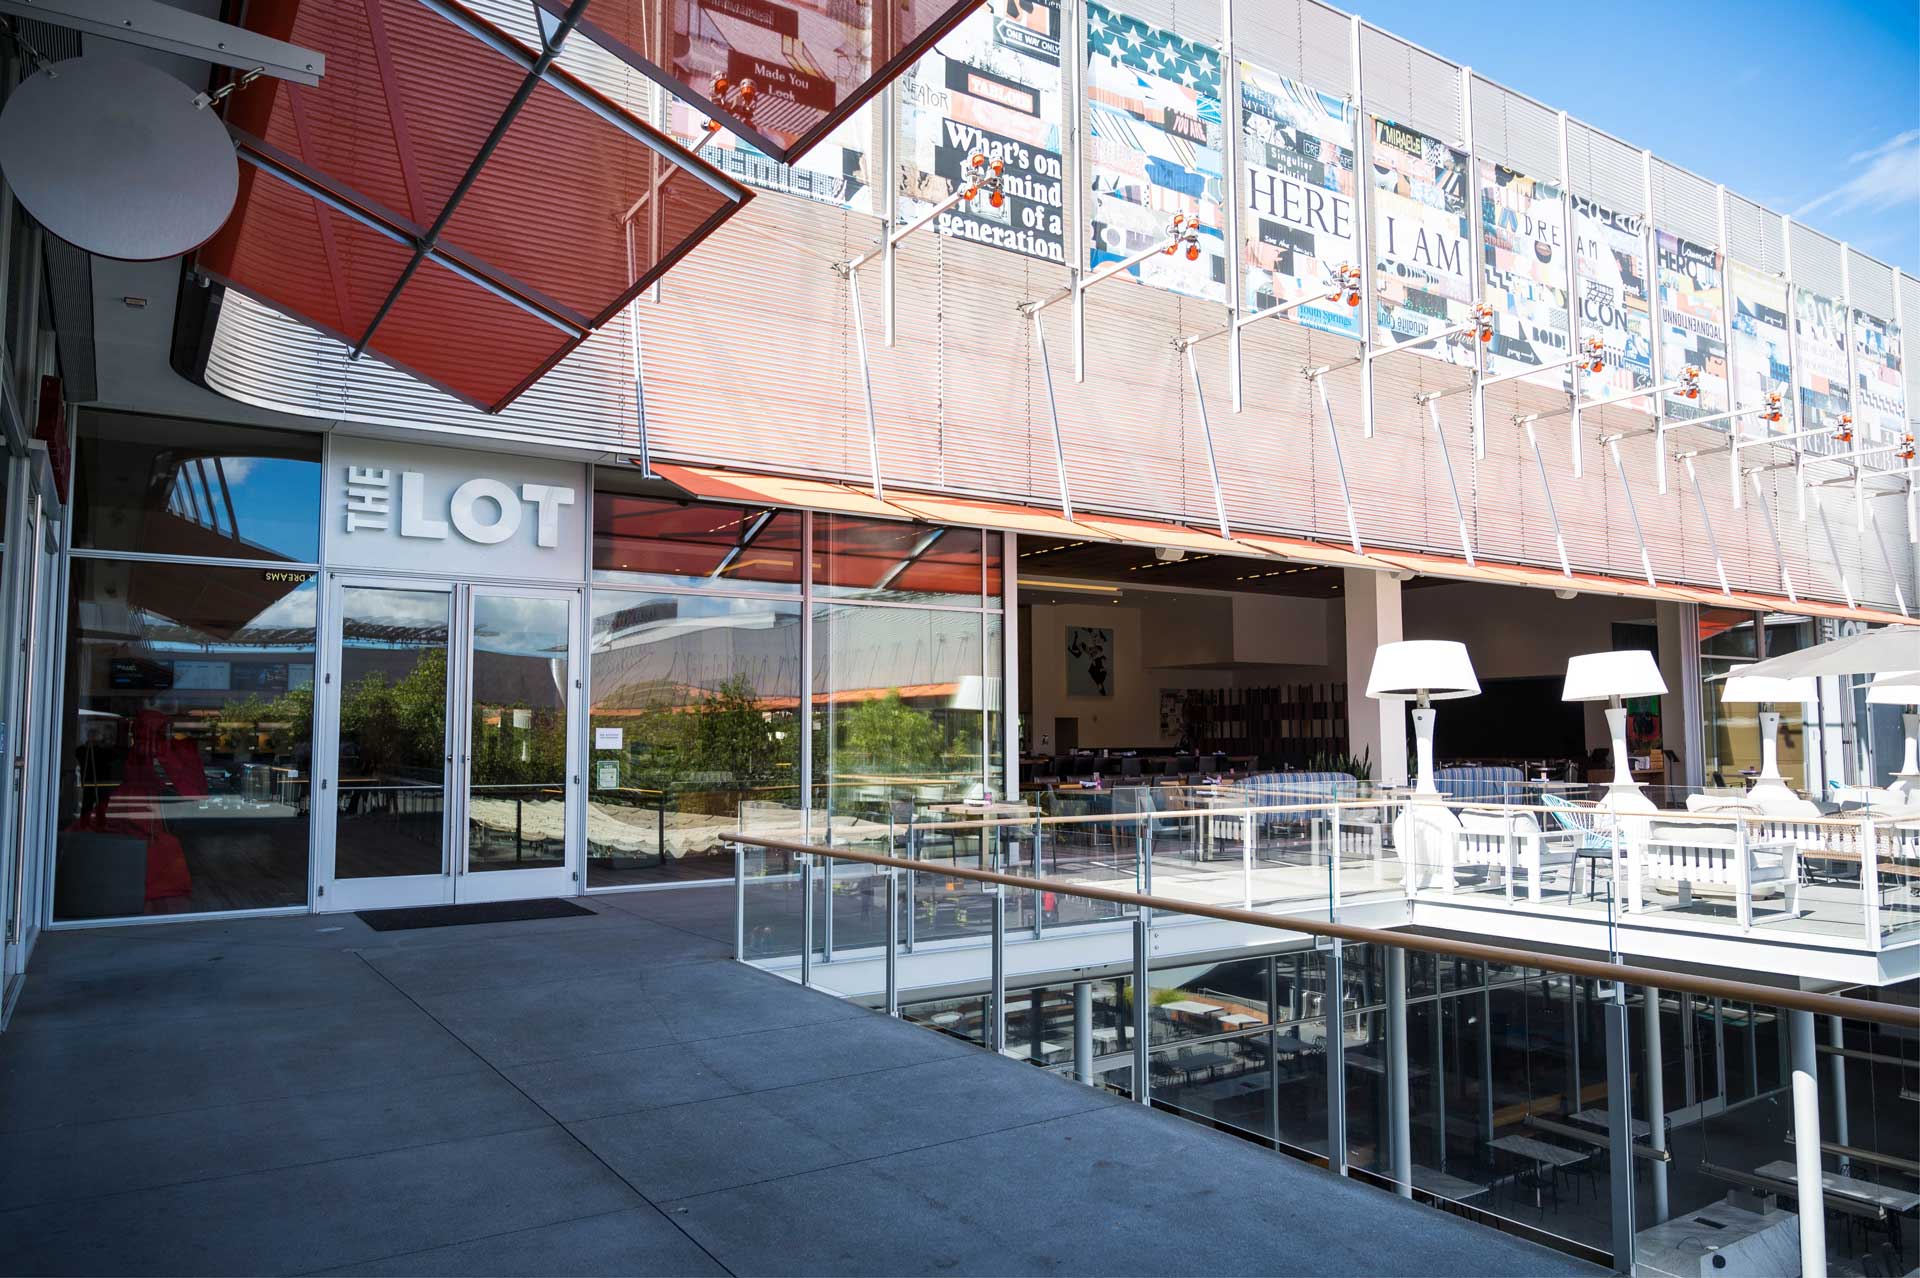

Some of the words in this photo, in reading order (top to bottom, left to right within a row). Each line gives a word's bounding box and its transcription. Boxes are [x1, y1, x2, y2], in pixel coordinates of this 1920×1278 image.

[1006, 28, 1023, 41] ONE
[1024, 34, 1040, 47] WAY
[1041, 39, 1061, 53] ONLY
[754, 63, 786, 82] Made
[788, 73, 809, 90] You
[768, 86, 796, 102] Look
[1243, 98, 1275, 118] MYTH
[1173, 115, 1190, 135] YOU
[943, 120, 1029, 169] What's
[1034, 156, 1061, 180] on
[1004, 170, 1062, 208] mind
[1247, 168, 1352, 239] HERE
[1021, 205, 1043, 231] of
[1048, 217, 1062, 235] a
[938, 212, 1065, 262] generation
[1386, 215, 1397, 255] I
[1412, 226, 1464, 276] AM
[1658, 247, 1698, 280] HERO
[1578, 296, 1628, 332] ICON
[1532, 326, 1566, 351] BOLD!
[346, 465, 390, 532] THE
[401, 471, 575, 547] LOT
[265, 572, 306, 583] DREAMS
